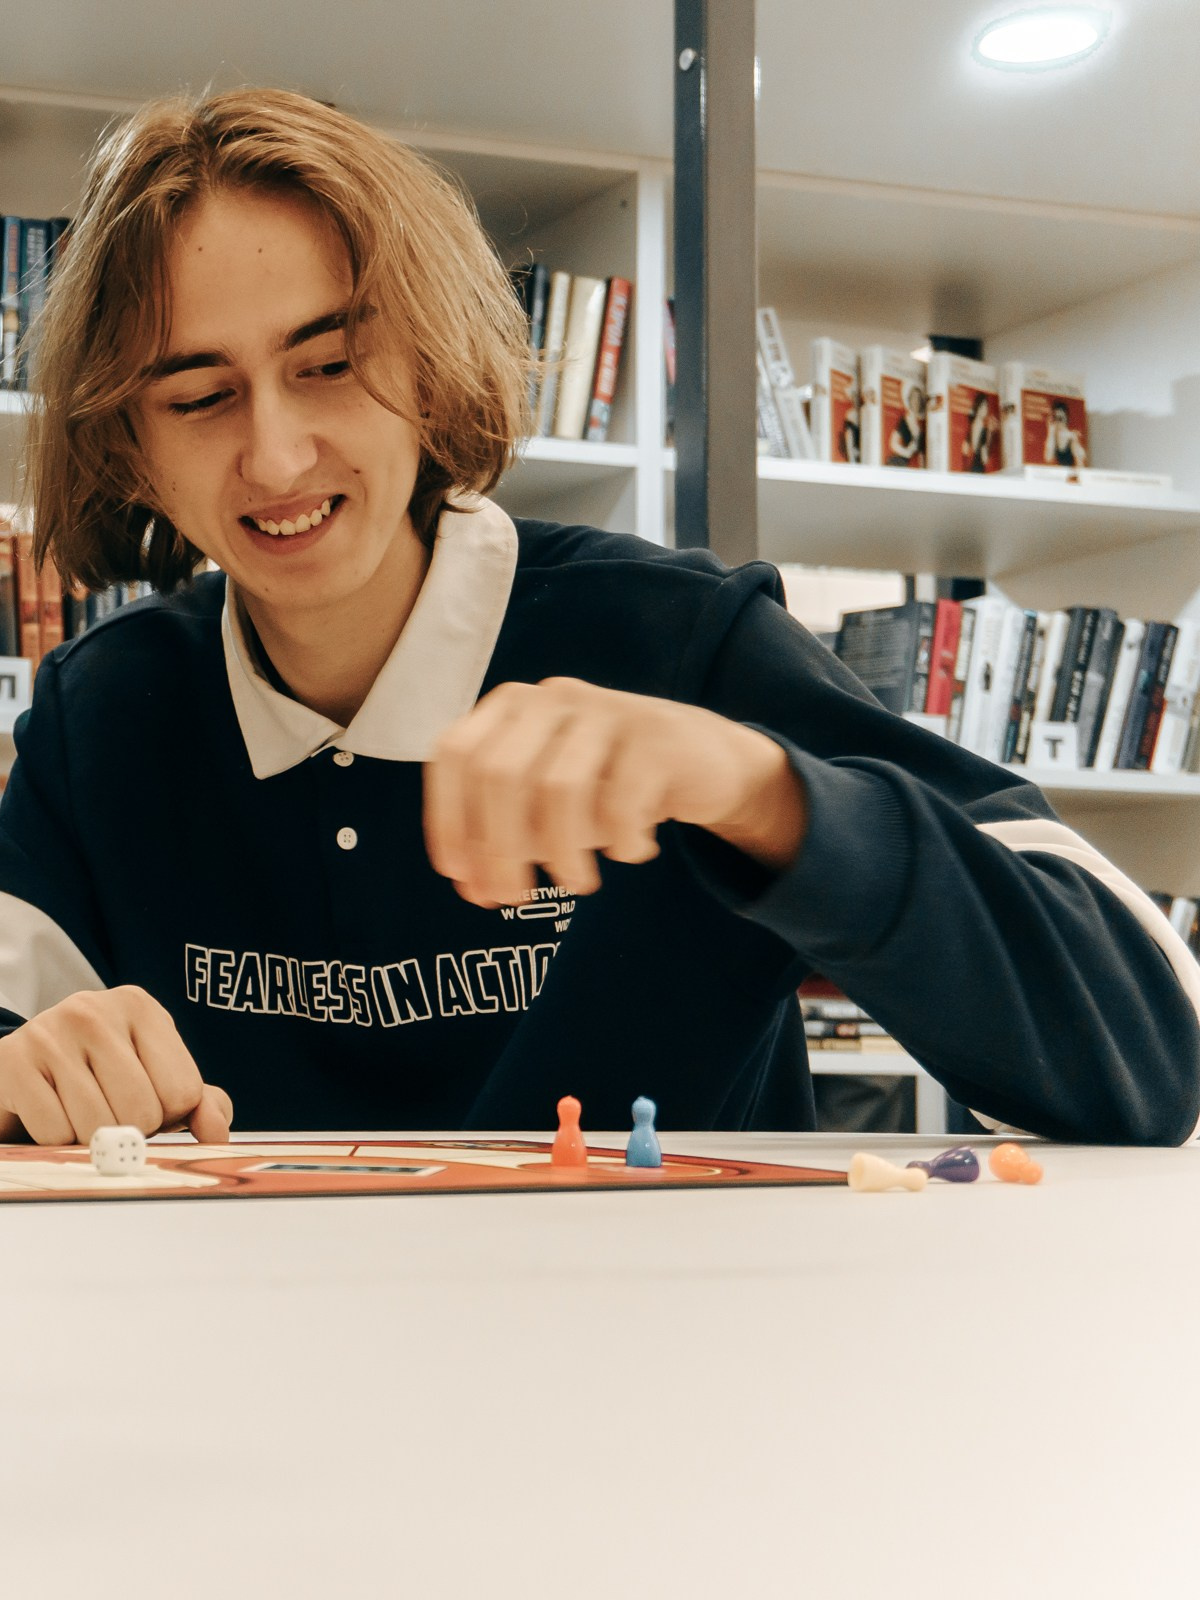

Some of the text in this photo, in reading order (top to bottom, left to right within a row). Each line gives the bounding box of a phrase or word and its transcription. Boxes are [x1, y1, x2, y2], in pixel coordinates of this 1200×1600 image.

[501, 901, 576, 920] WORLD
[185, 943, 372, 1027] FEARLESS
[370, 958, 433, 1028] IN
